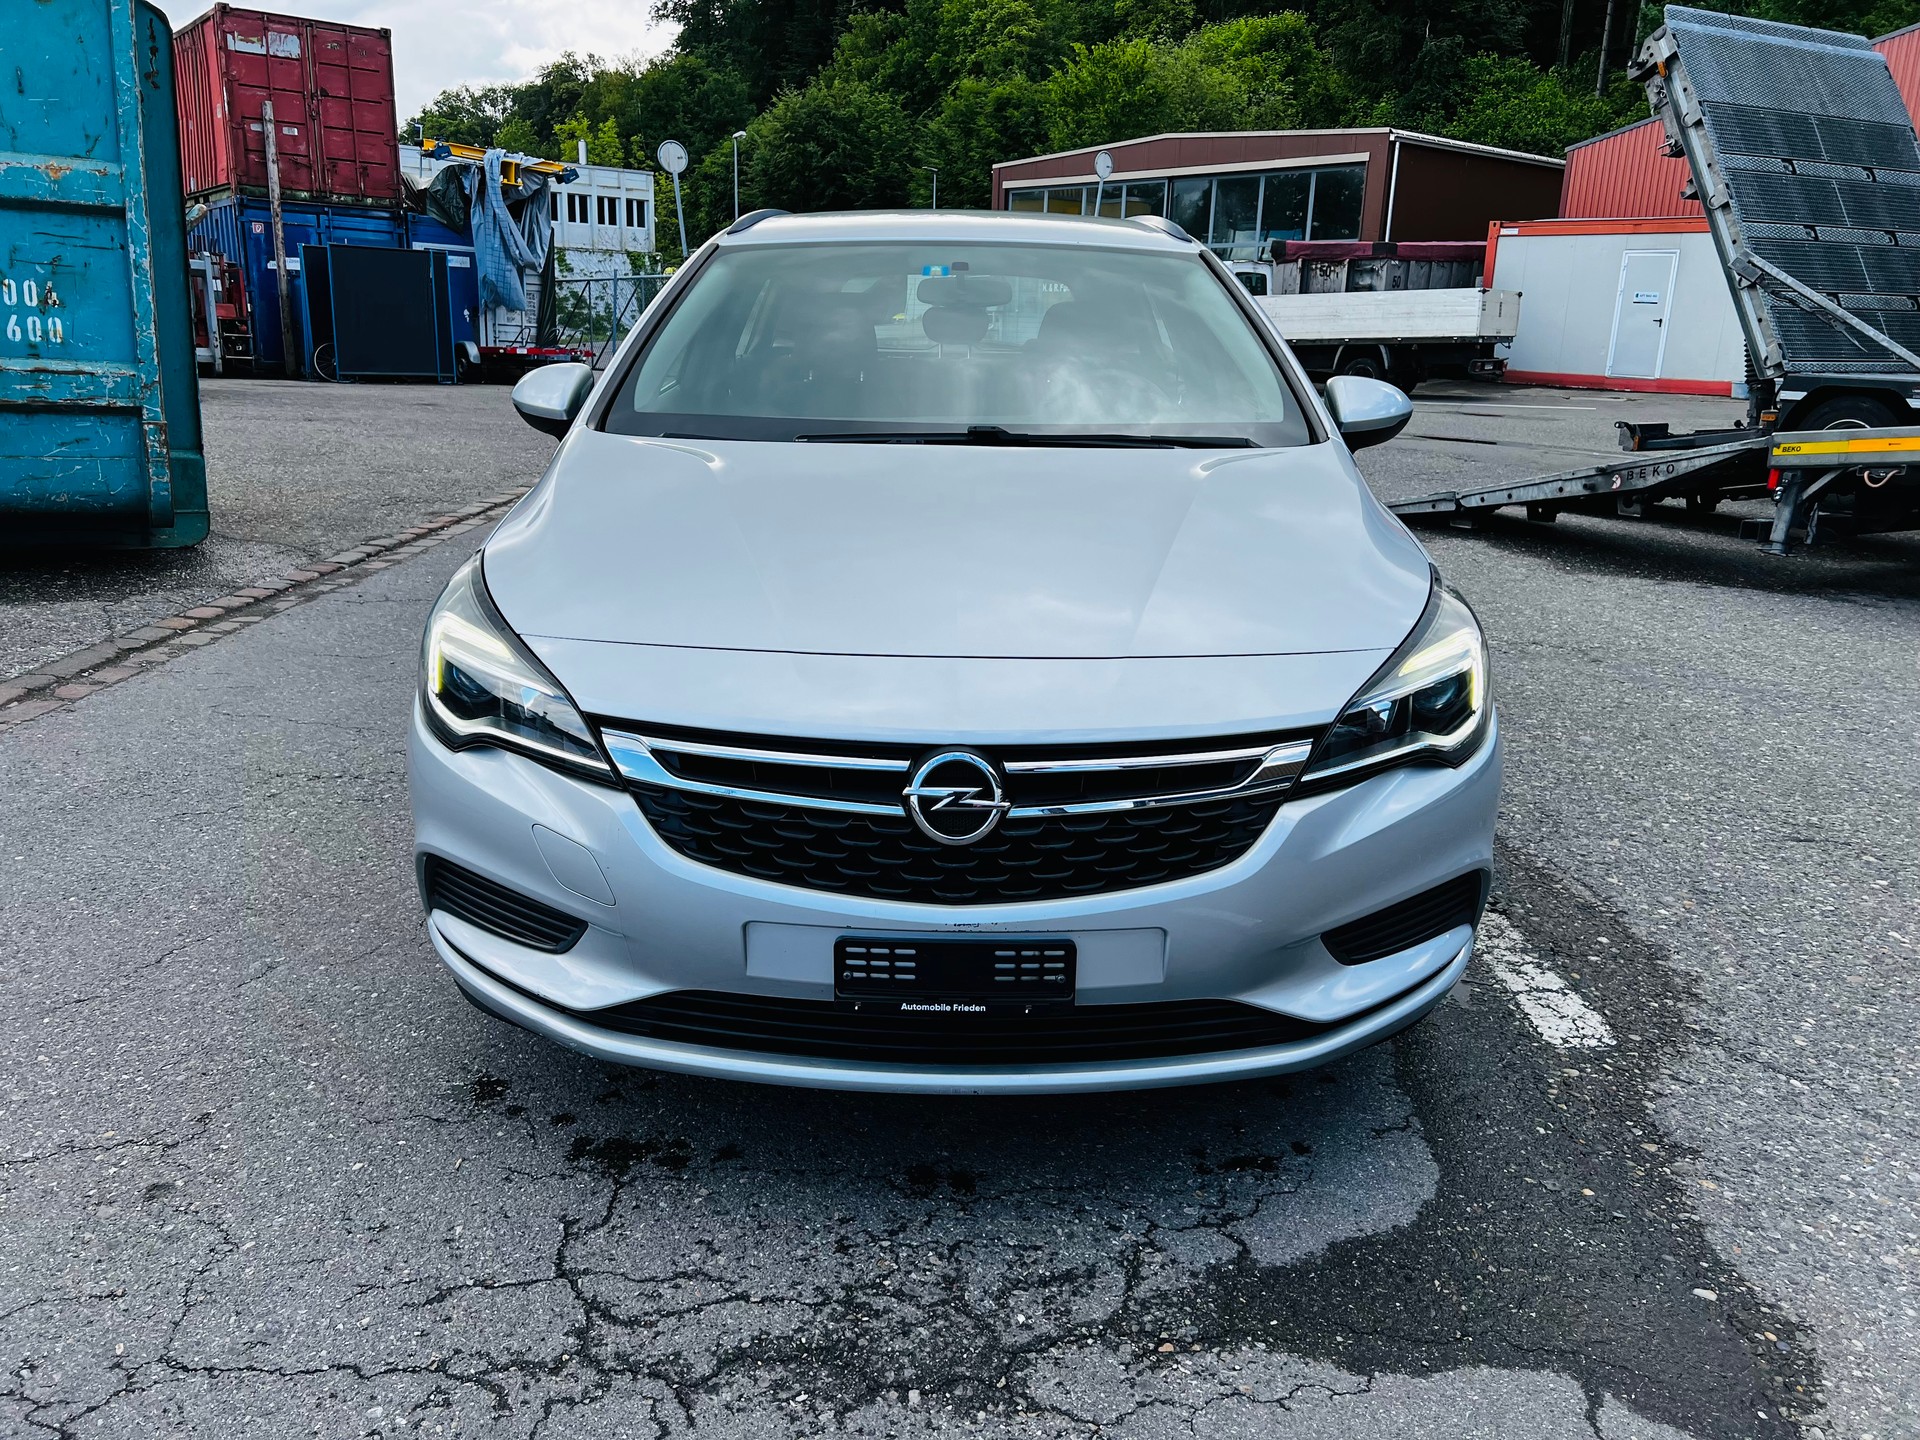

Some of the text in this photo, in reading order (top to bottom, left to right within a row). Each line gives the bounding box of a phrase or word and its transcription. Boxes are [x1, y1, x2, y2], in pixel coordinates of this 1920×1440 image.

[6, 314, 63, 344] 600
[1781, 445, 1802, 453] BEKO
[1626, 463, 1675, 481] BEKO
[901, 1003, 986, 1012] Automobile Frieden
